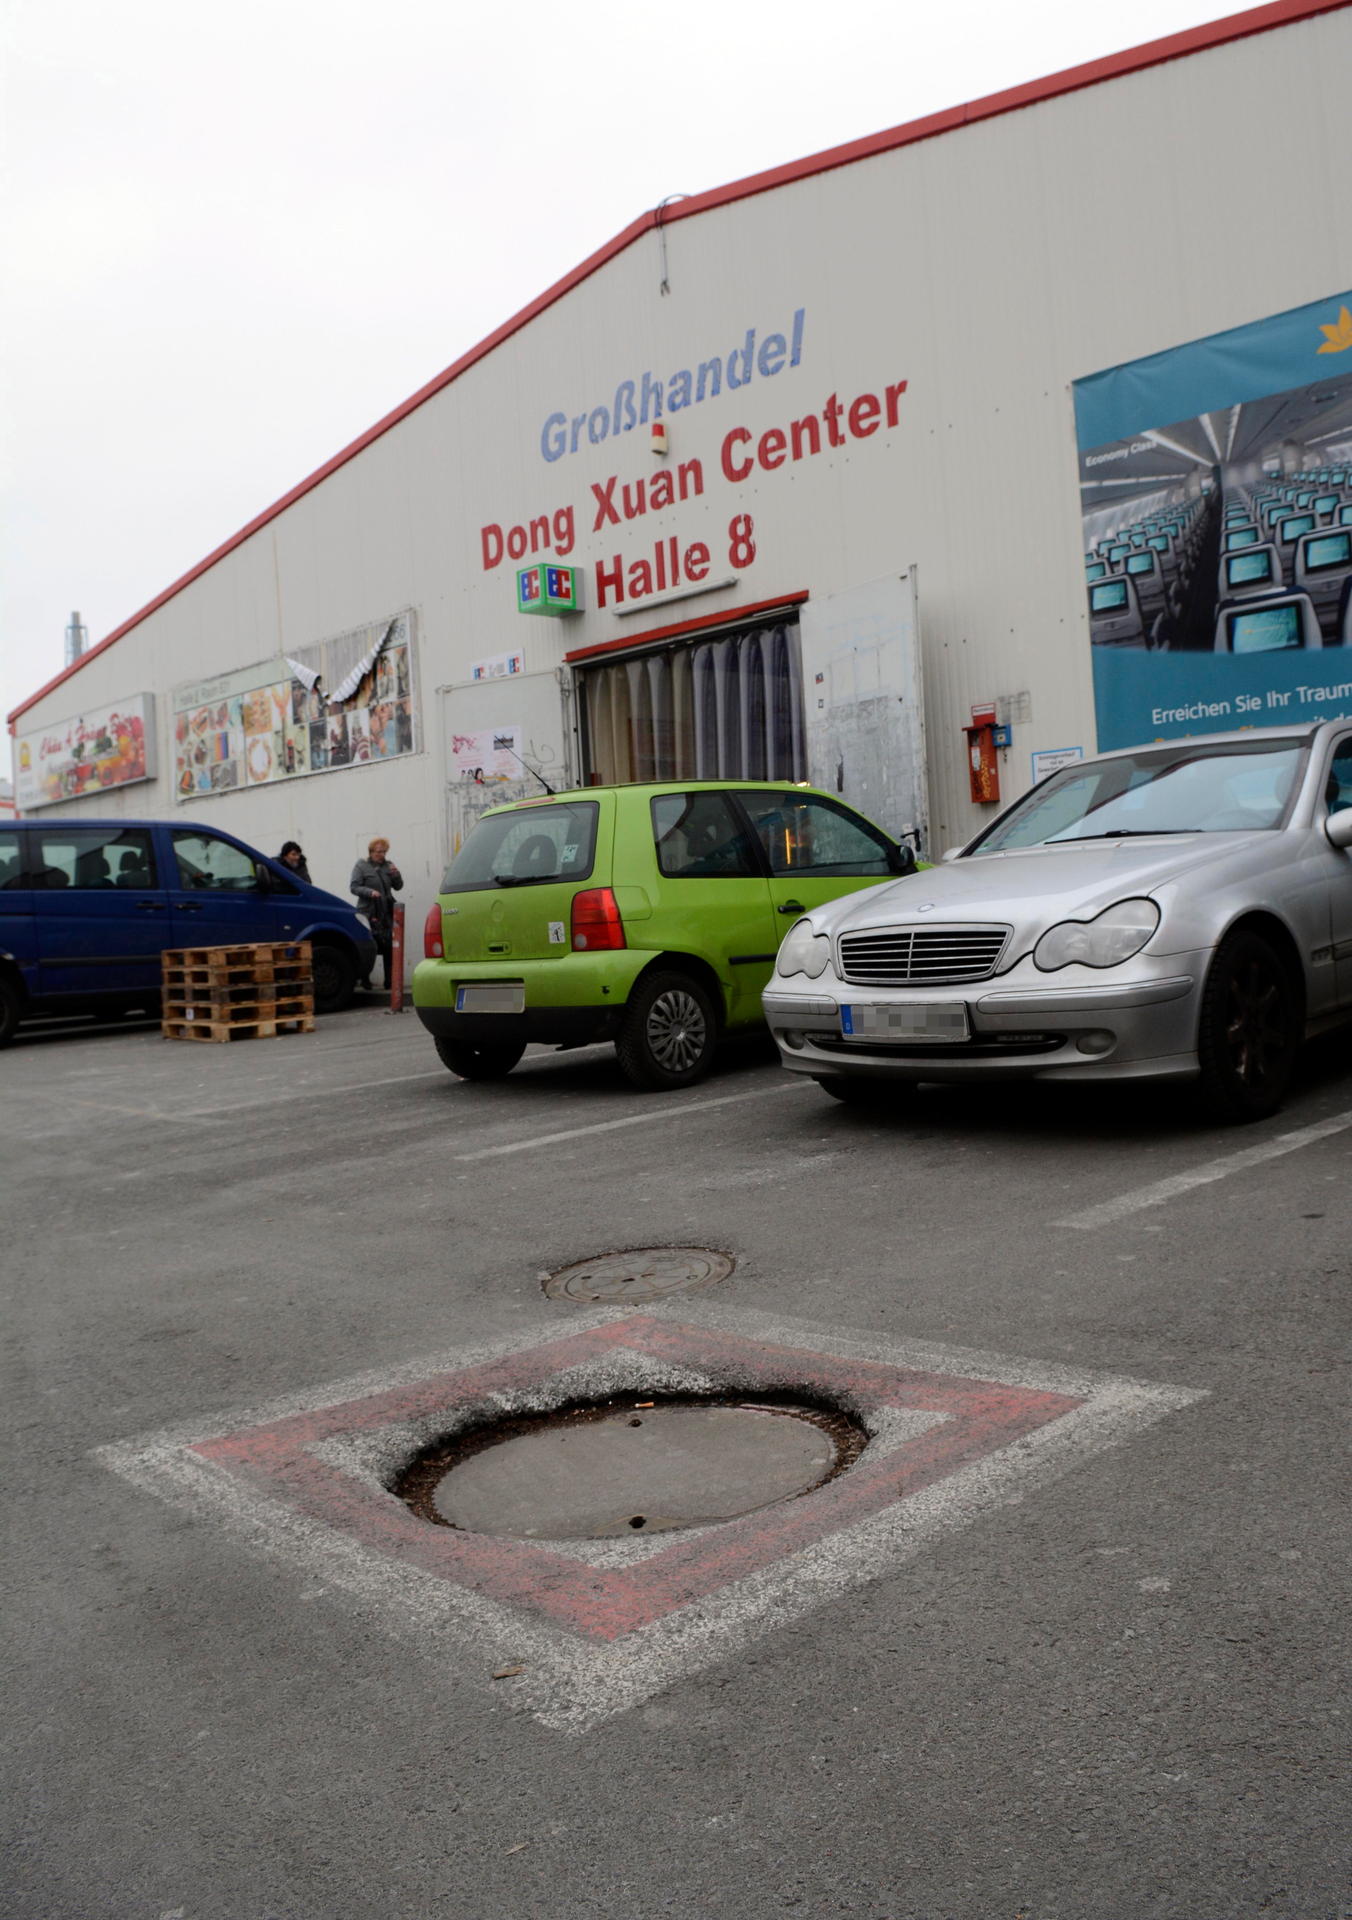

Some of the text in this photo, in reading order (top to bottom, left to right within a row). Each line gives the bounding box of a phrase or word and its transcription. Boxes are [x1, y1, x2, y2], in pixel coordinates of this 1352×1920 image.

[540, 308, 806, 463] Großhandel
[481, 380, 908, 571] Dong Xuan Center
[1085, 441, 1157, 467] Economy Class
[595, 513, 757, 608] Halle 8
[1152, 701, 1231, 725] Erreichen
[1235, 694, 1262, 713] Sie
[1266, 691, 1292, 708] Ihr
